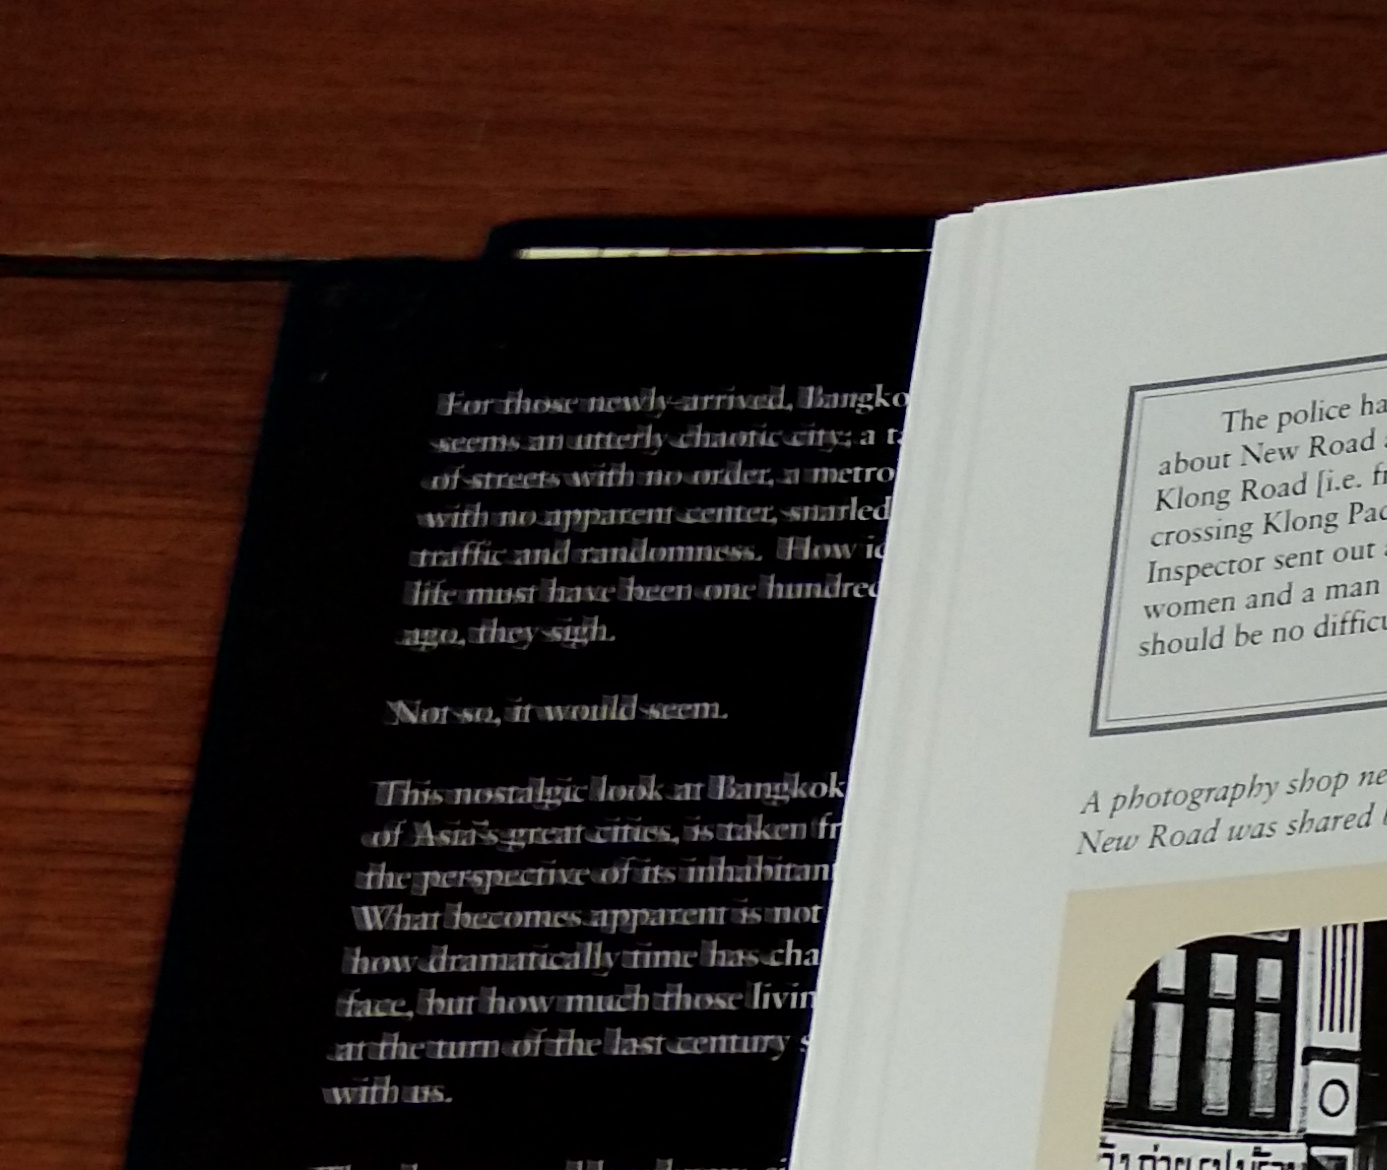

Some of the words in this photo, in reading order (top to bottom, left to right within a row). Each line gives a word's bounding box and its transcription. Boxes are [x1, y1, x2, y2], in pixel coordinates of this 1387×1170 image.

[1221, 407, 1269, 435] The
[1276, 399, 1352, 435] police
[1150, 517, 1254, 548] crossing
[1262, 508, 1339, 537] Klong
[1143, 595, 1236, 620] women
[1244, 580, 1294, 611] and
[1301, 586, 1315, 604] a
[1324, 578, 1380, 602] man
[1079, 789, 1100, 815] A
[1108, 772, 1280, 820] photography
[1285, 767, 1350, 798] shop
[1075, 828, 1140, 856] New
[1147, 816, 1222, 850] Road
[1227, 820, 1278, 843] was
[1285, 800, 1376, 837] shared
